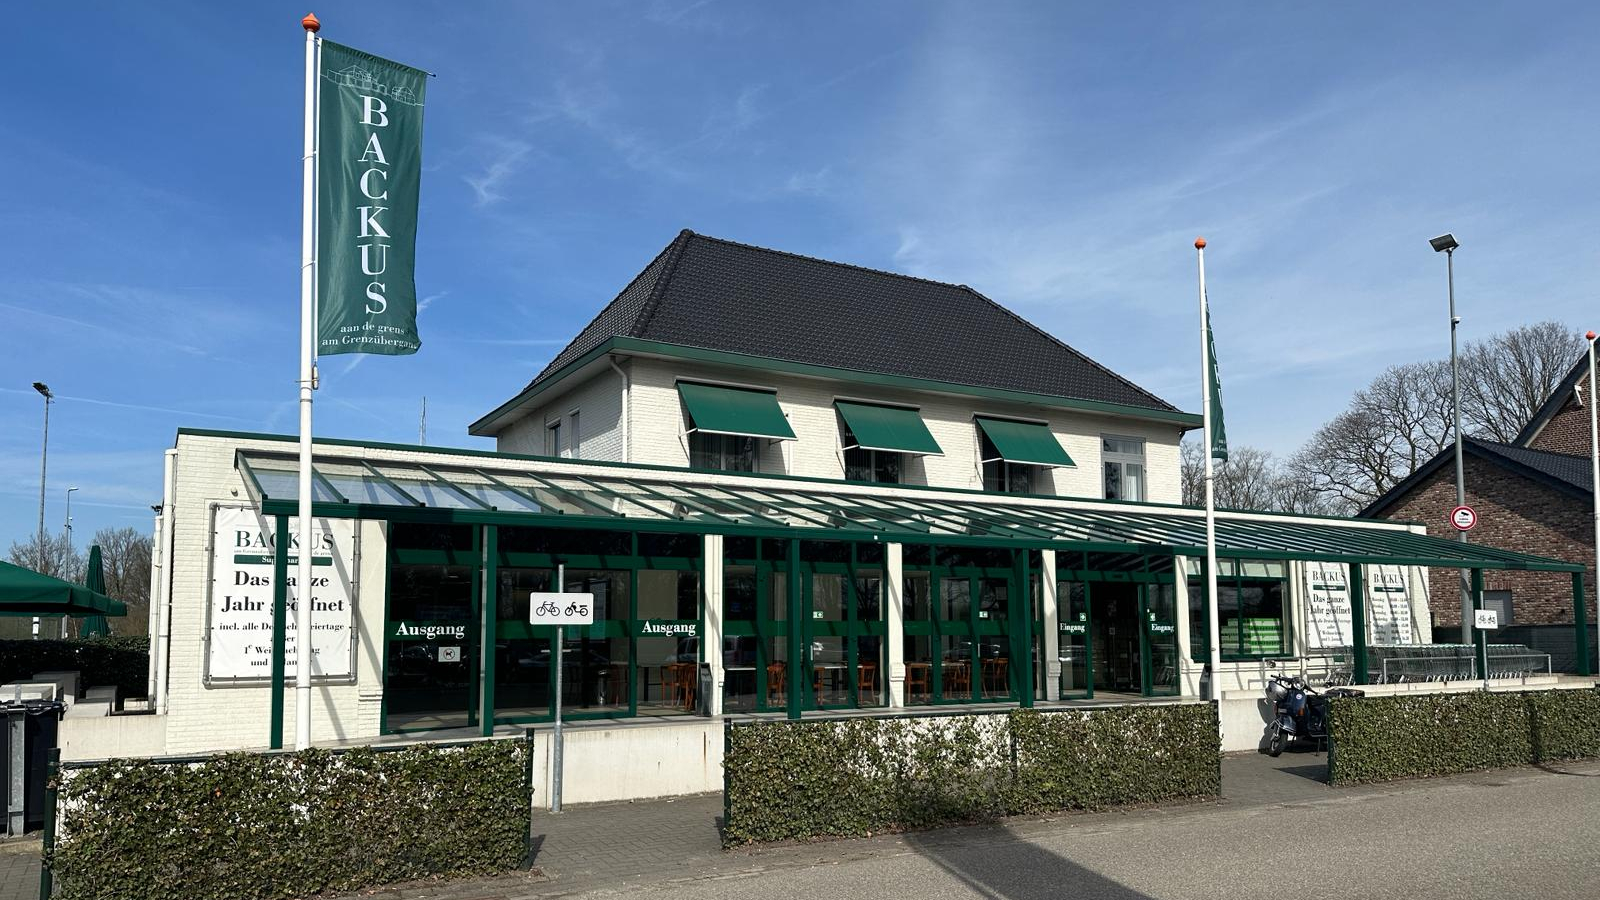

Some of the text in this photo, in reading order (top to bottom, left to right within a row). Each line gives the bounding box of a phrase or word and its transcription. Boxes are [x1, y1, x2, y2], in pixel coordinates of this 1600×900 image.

[357, 94, 391, 315] BACKUS
[362, 322, 375, 331] de
[378, 325, 405, 335] grens
[233, 570, 270, 586] Das
[1312, 571, 1345, 581] BACKUS
[1374, 573, 1404, 584] BACKUS
[1313, 593, 1325, 602] Das
[221, 596, 265, 612] Jahr
[219, 622, 240, 630] incl.
[242, 622, 259, 630] alle
[310, 623, 345, 632] eiertage
[395, 621, 465, 640] Ausgang
[641, 620, 696, 637] Ausgang
[1059, 622, 1085, 633] Eingang
[1151, 623, 1174, 633] Eingang
[250, 658, 268, 666] und
